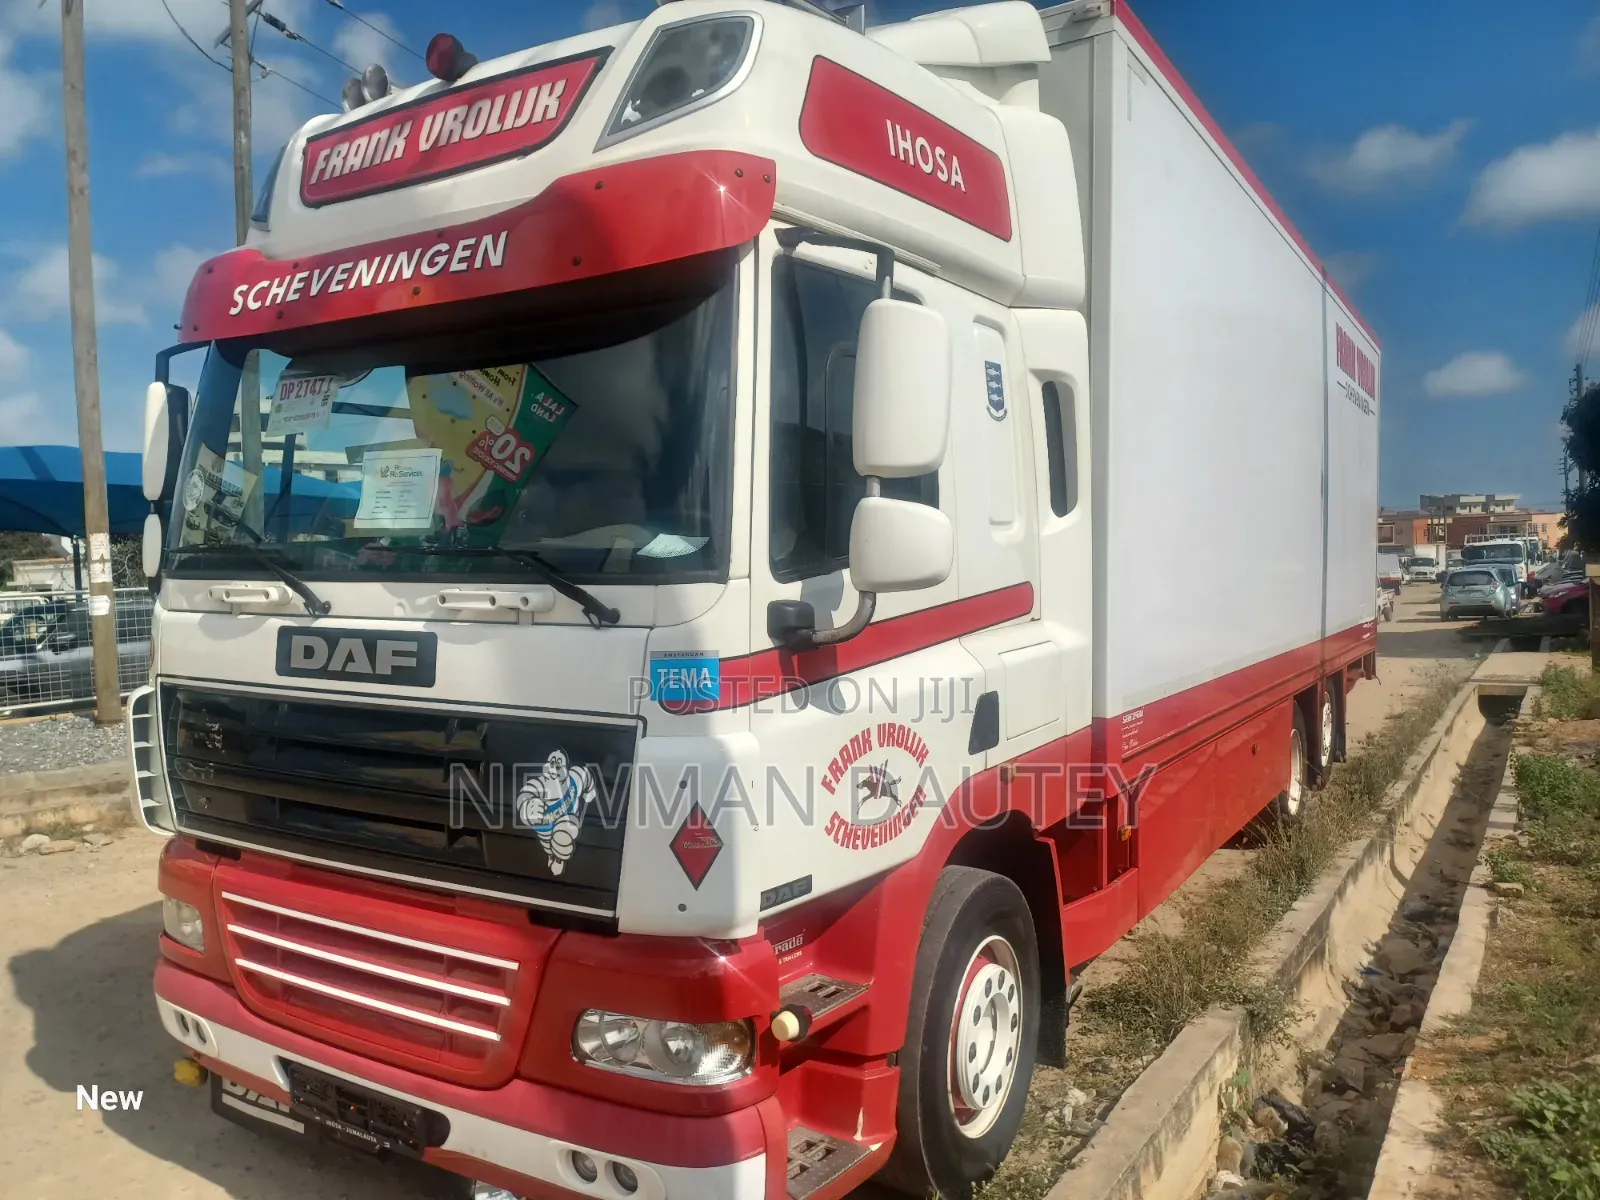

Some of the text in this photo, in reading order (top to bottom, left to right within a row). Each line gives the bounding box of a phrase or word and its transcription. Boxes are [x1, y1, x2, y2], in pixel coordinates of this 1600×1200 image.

[309, 79, 567, 186] FRANK VROLIJK
[886, 118, 966, 193] IHOSA
[229, 230, 508, 316] SCHEVENINGEN
[290, 635, 418, 675] DAF
[657, 667, 712, 689] TEMA
[821, 722, 929, 795] FRANK VROLIJK
[824, 784, 928, 851] SCHEVENINGEN
